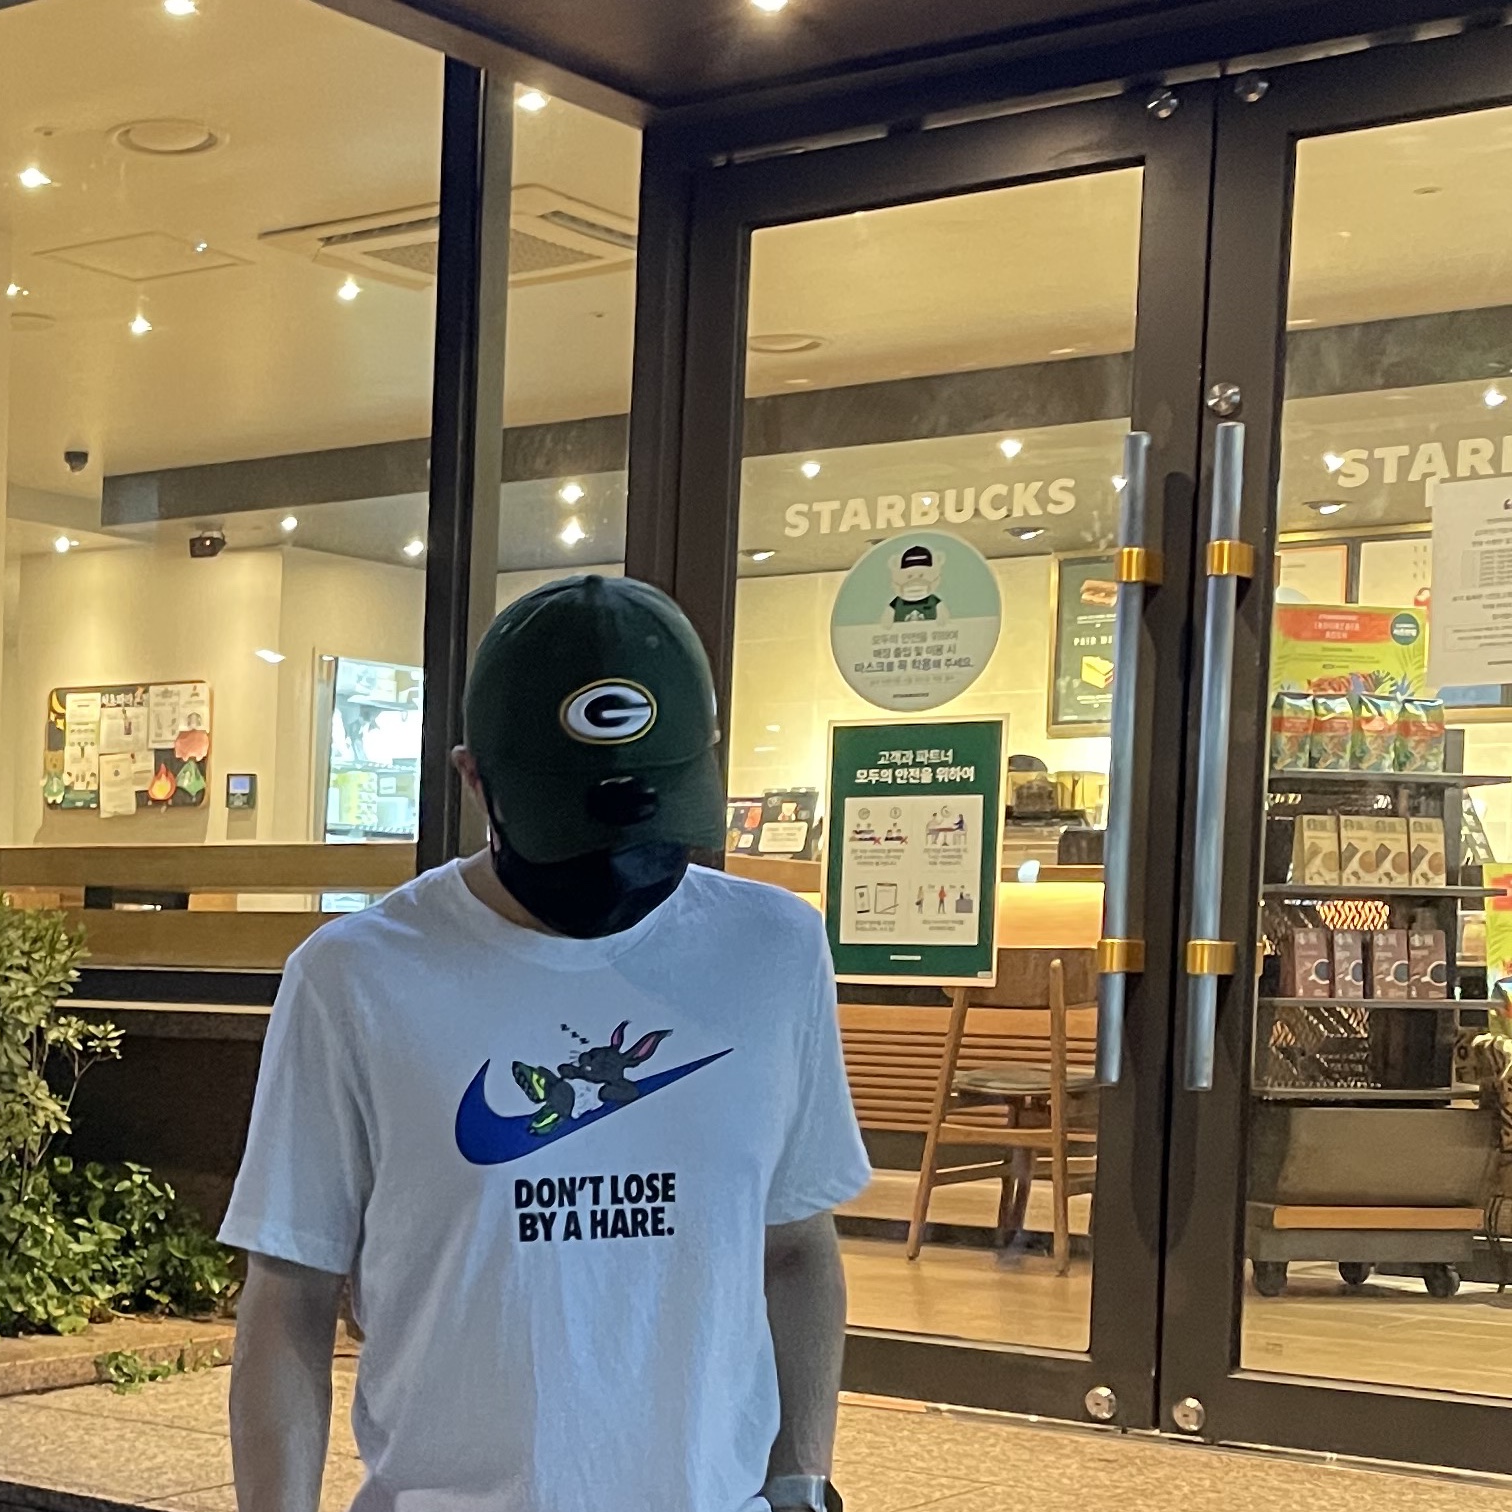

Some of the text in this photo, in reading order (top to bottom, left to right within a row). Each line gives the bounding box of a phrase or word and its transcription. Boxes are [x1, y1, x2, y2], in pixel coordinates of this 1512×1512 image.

[784, 477, 1077, 538] STARBUCKS
[854, 660, 894, 673] 마스크를
[876, 748, 954, 766] 고객과 파트너
[854, 765, 975, 785] 모두의 안전을 위하여
[514, 1172, 676, 1209] DON'T LOSE
[519, 1206, 675, 1243] BY A HARE.
